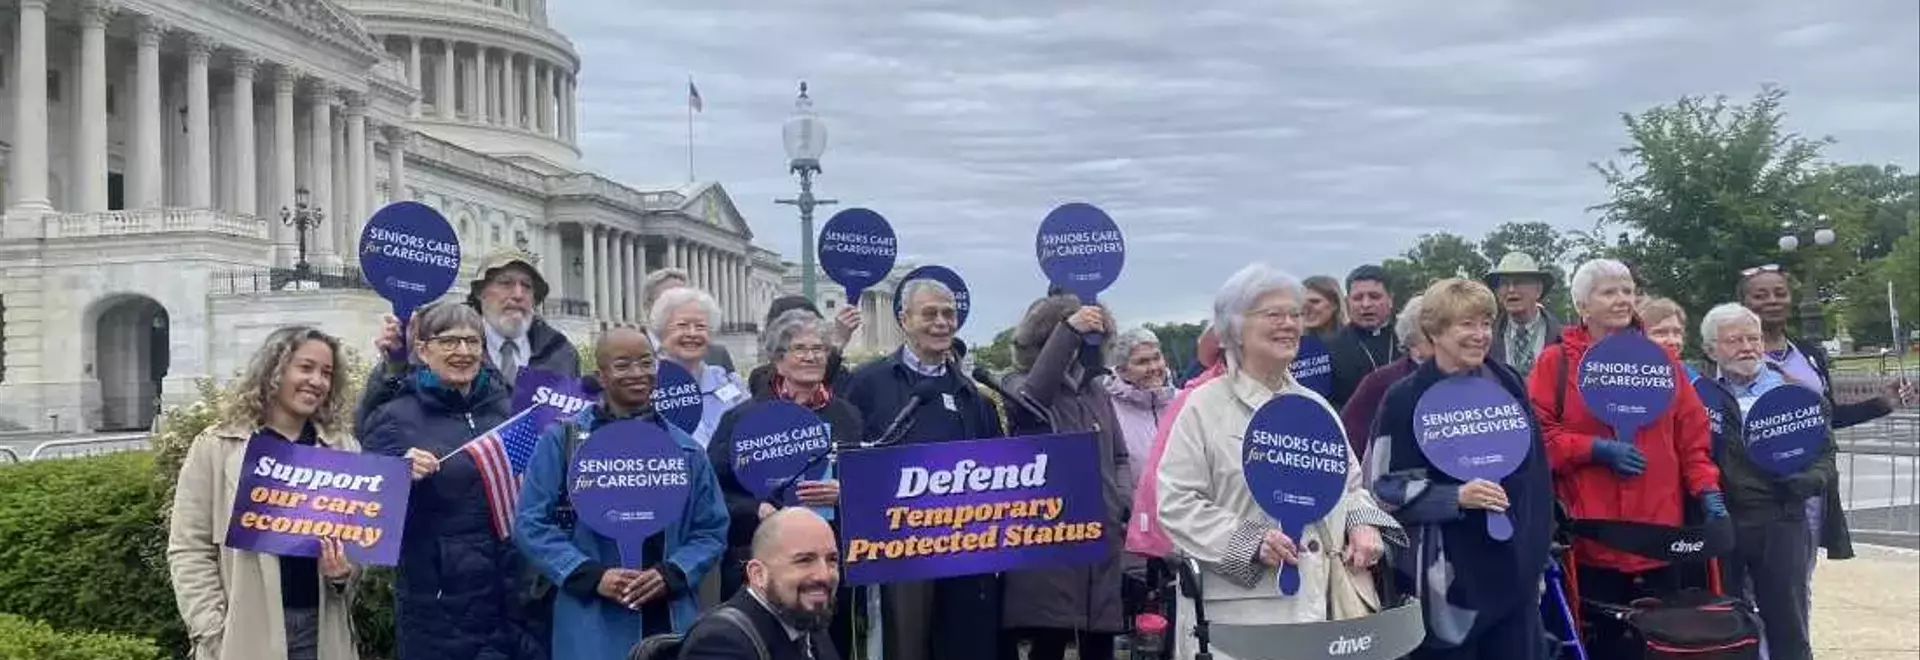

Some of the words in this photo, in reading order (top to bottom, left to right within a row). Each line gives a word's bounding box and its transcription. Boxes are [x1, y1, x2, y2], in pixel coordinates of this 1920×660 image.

[370, 226, 424, 248] SENIORS
[427, 240, 458, 257] CARE
[825, 230, 868, 244] SENIORS
[870, 236, 895, 247] CARE
[1042, 231, 1090, 245] SENIORS
[1092, 230, 1120, 242] CARE
[1057, 242, 1122, 256] CAREGIVERS
[383, 244, 458, 269] CAREGIVERS
[837, 243, 896, 257] CAREGIVERS
[1312, 354, 1330, 366] CARE
[1585, 361, 1638, 375] SENIORS
[1641, 364, 1673, 376] CARE
[667, 383, 697, 399] CARE
[1600, 375, 1674, 389] CAREGIVERS
[655, 395, 701, 412] EGIVERS
[1422, 408, 1482, 426] SENIORS
[1484, 404, 1520, 419] CARE
[1750, 412, 1794, 431] SENIORS
[1796, 404, 1821, 419] CARE
[1762, 415, 1825, 440] CAREGIVERS
[736, 431, 789, 452] SENIORS
[791, 425, 823, 441] CARE
[1423, 428, 1440, 445] for
[1442, 417, 1528, 438] CAREGIVERS
[753, 438, 828, 461] CAREGIVERS
[1252, 430, 1309, 451] SENIORS
[1312, 440, 1345, 457] CARE
[579, 459, 645, 473] SENIORS
[647, 458, 685, 471] CARE
[1246, 447, 1266, 464] for
[1267, 450, 1346, 475] CAREGIVERS
[253, 455, 384, 493] Support
[575, 475, 596, 490] for
[597, 472, 688, 488] CAREGIVERS
[895, 453, 1048, 499] Defend
[250, 486, 308, 508] our
[311, 495, 382, 517] care
[886, 497, 1064, 531] Temporary
[240, 511, 383, 548] economy
[846, 525, 999, 563] Protected
[1002, 521, 1103, 547] Status
[1328, 635, 1372, 656] drive
